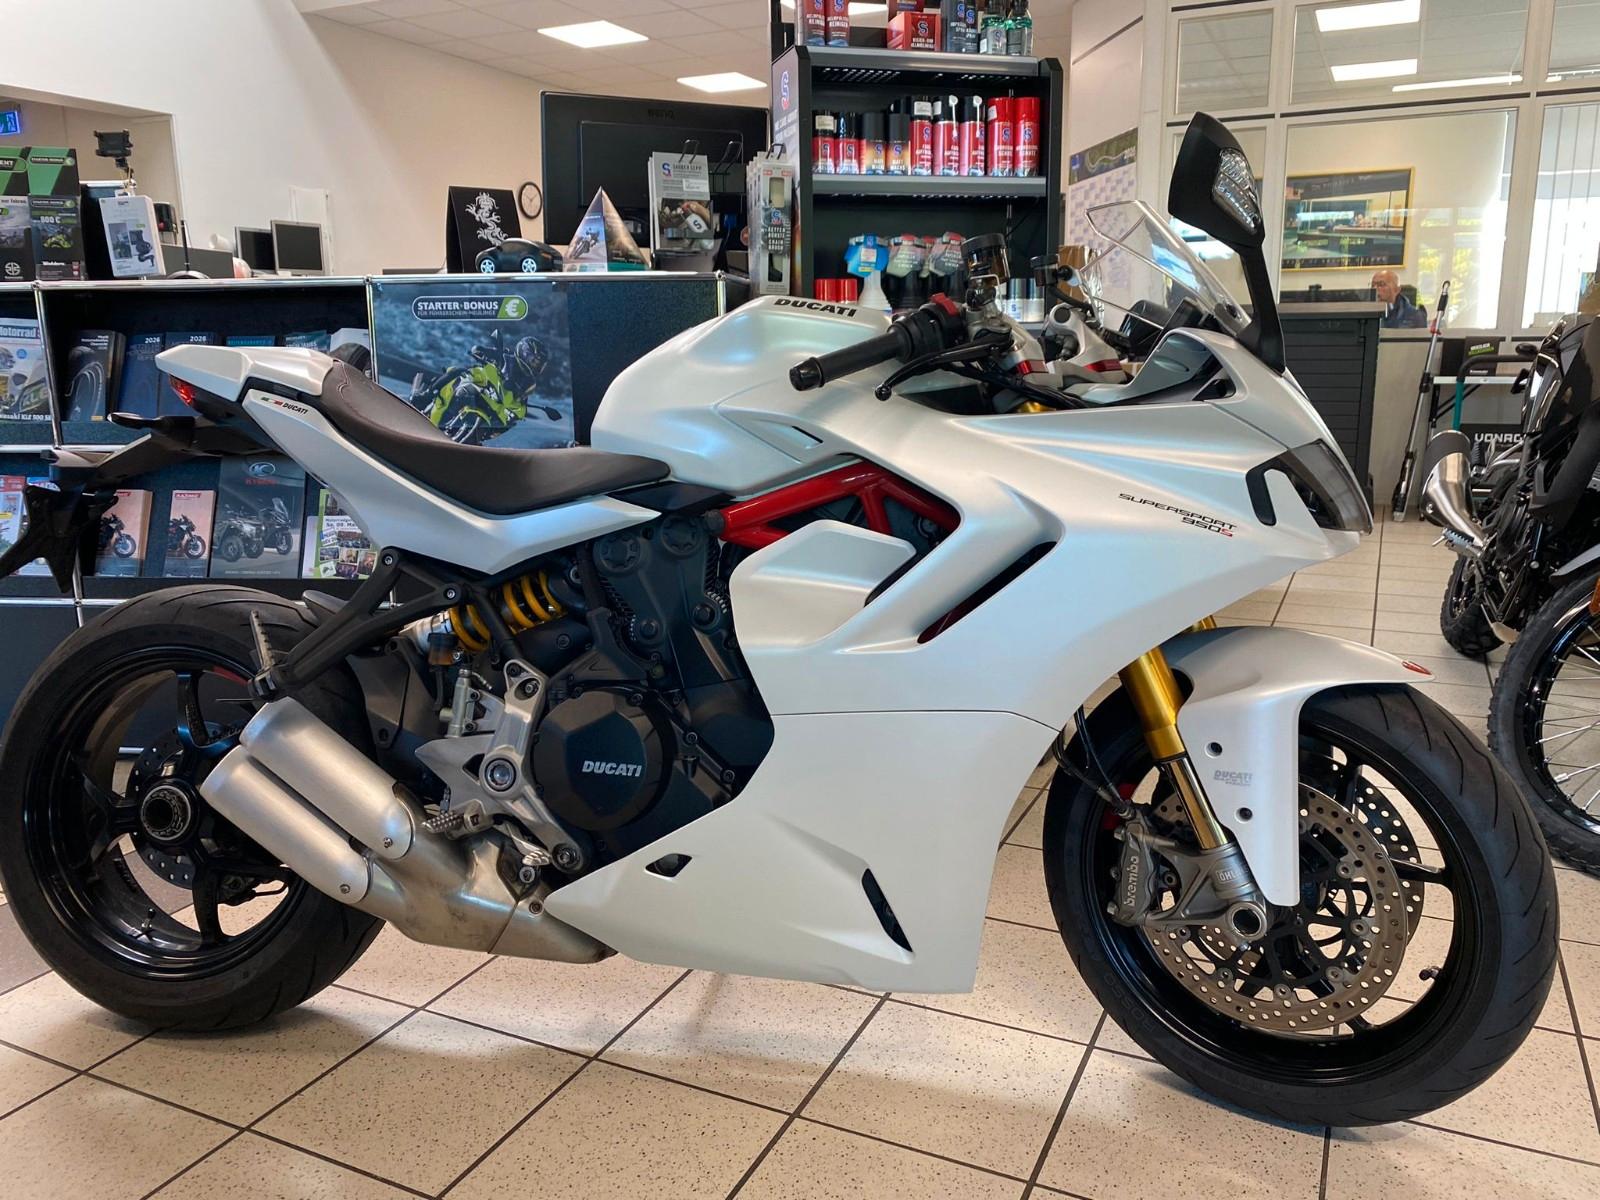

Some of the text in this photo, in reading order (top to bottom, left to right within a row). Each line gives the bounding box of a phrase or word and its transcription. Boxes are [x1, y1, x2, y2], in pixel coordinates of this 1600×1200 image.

[774, 298, 857, 317] DUCATI
[282, 402, 309, 415] DUCATI
[1119, 493, 1237, 530] SUPERSPORT
[582, 760, 642, 777] DUCATI
[1124, 855, 1140, 907] brembo
